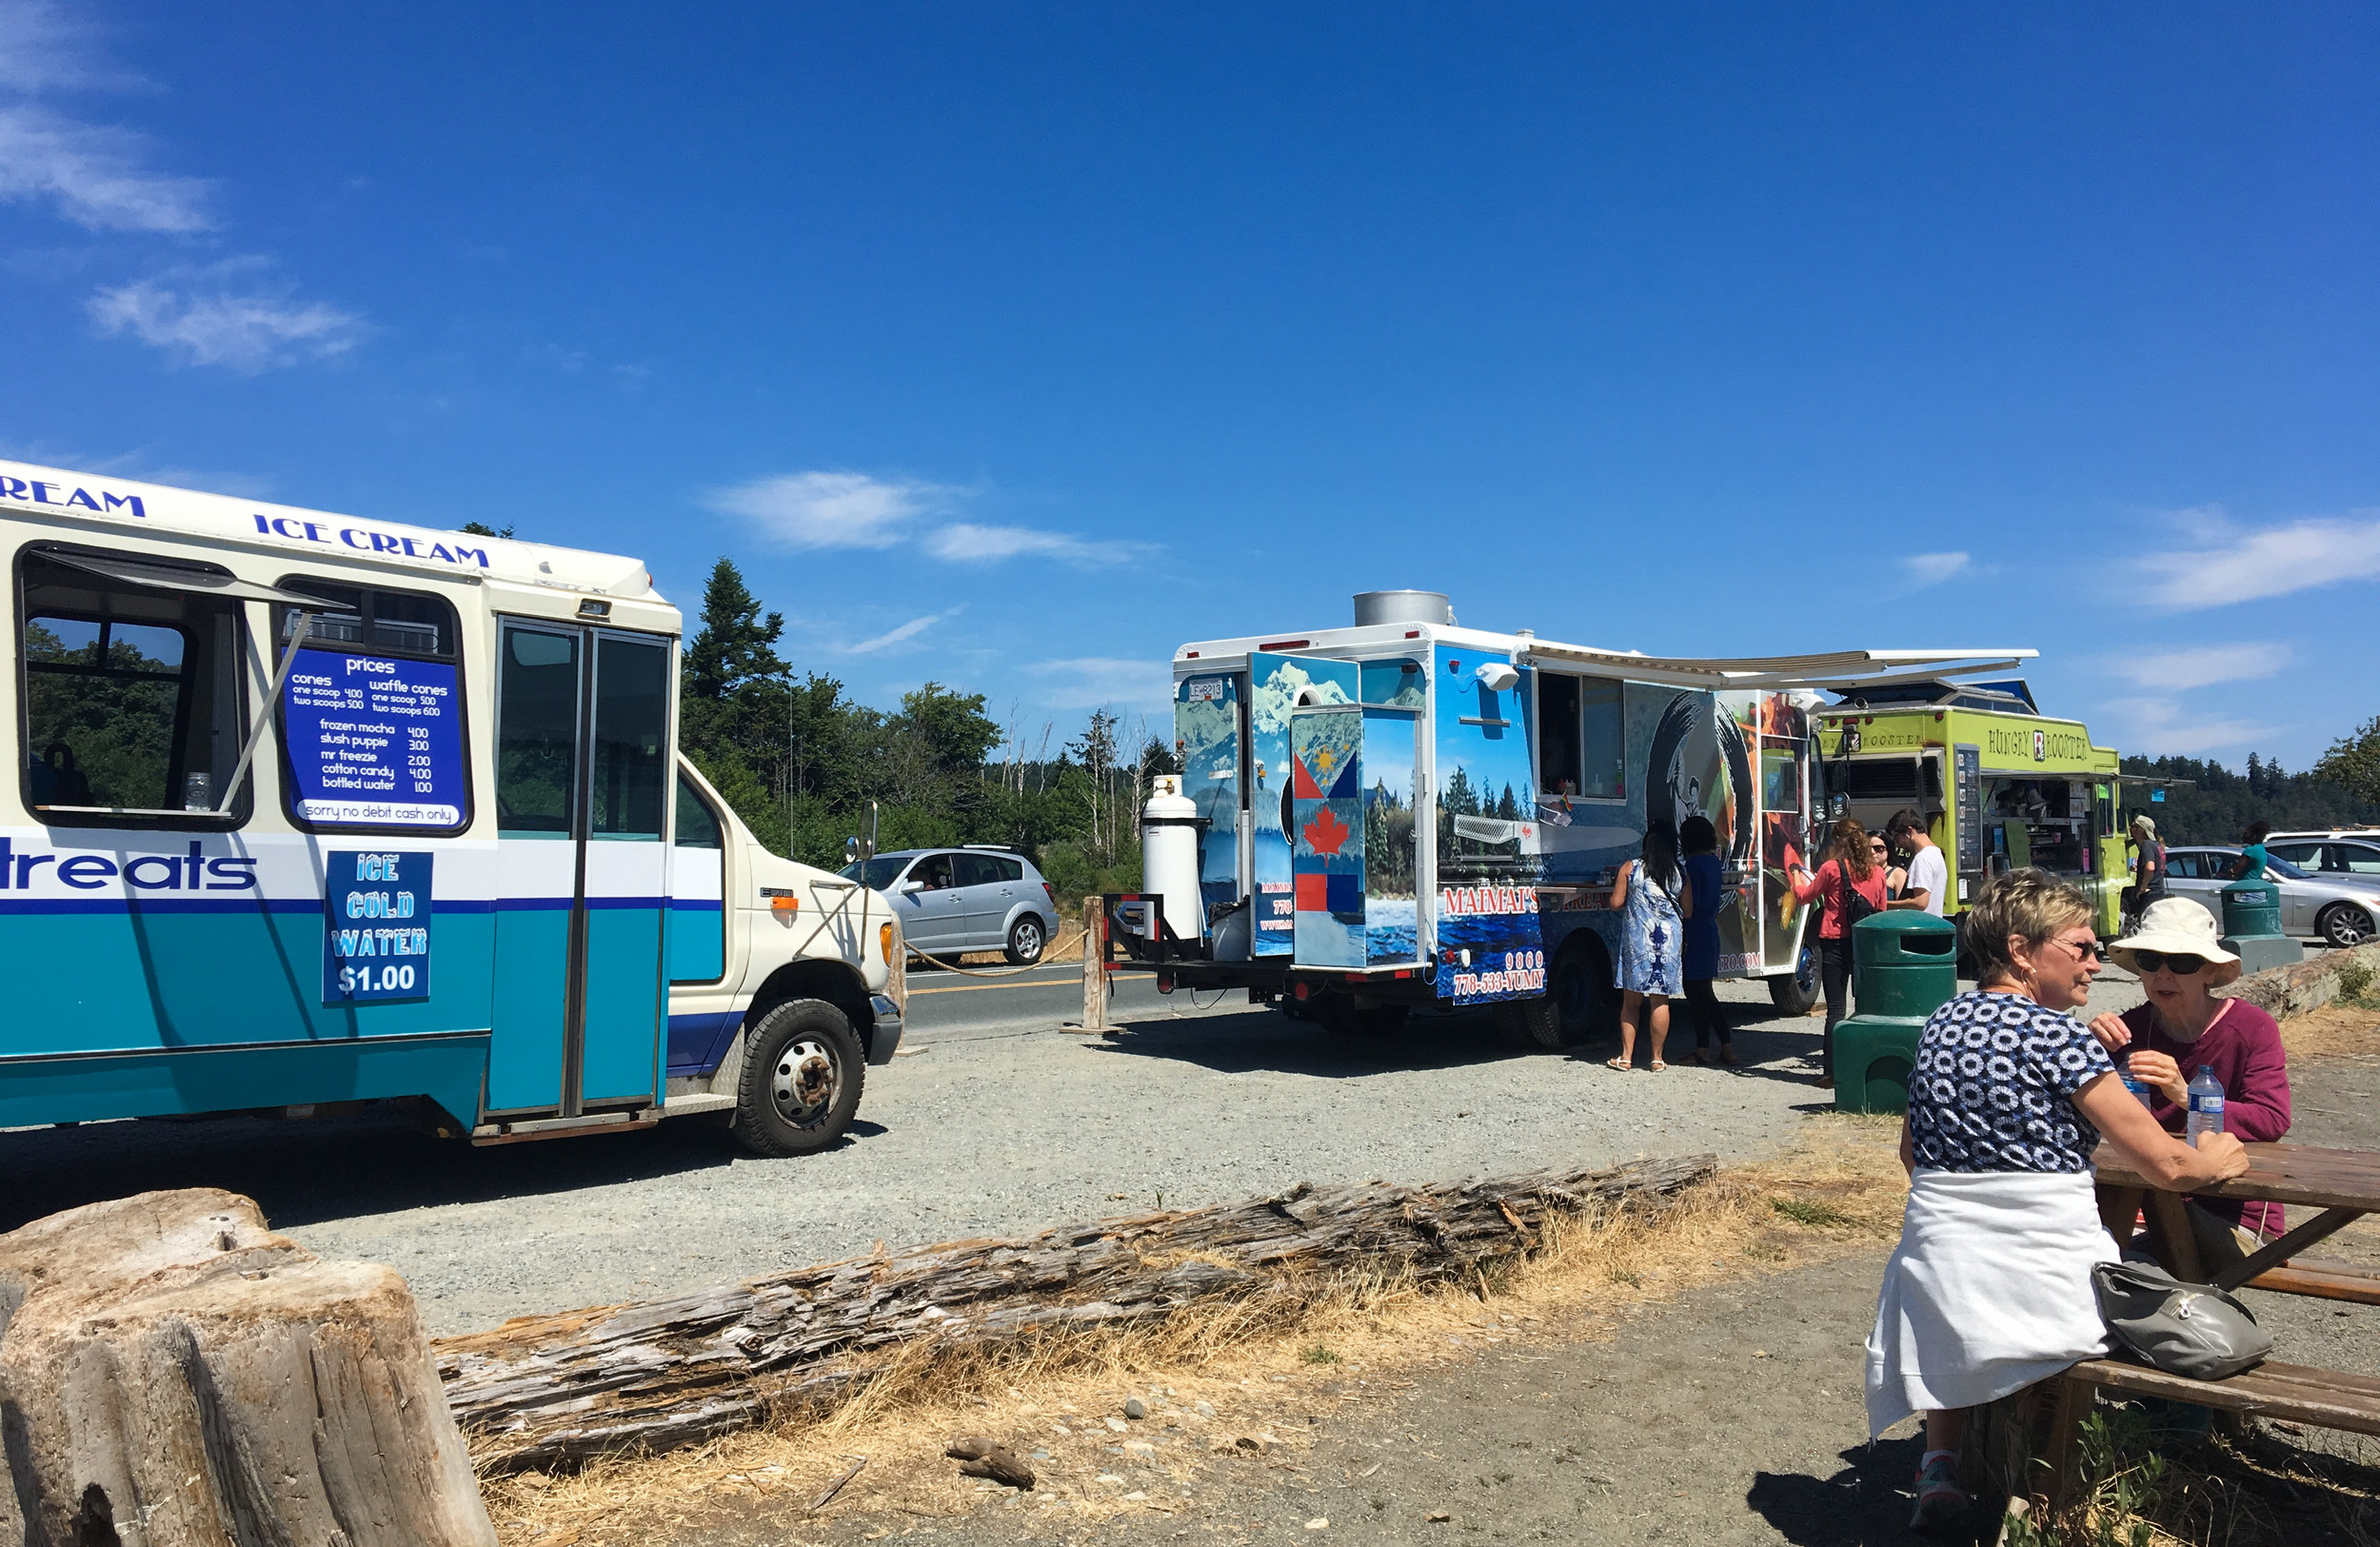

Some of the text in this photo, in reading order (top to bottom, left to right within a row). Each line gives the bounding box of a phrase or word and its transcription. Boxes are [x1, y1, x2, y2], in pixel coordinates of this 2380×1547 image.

[253, 513, 490, 568] ICE CREAM
[346, 658, 395, 675] prices
[291, 673, 332, 686] cones
[369, 679, 448, 697] waffle cones
[292, 686, 363, 699] one scoop 4.00
[371, 693, 436, 706] one scoop 5.00
[293, 696, 365, 710] two scoops 5.00
[372, 703, 441, 717] two scoops 6.00
[319, 718, 428, 739] frozen mocha 4.00
[320, 732, 429, 751] slush puppie 3.00
[1862, 734, 1923, 747] ROOSTER
[1989, 729, 2088, 761] HUNGRY ROOSTER
[321, 749, 431, 766] mr freezie 2.00
[322, 763, 431, 780] cotton candy 4.00
[322, 776, 432, 793] bottled water 1.00
[306, 804, 452, 823] sorry no debit cash only
[0, 837, 258, 890] treats
[356, 853, 400, 882] ICE
[347, 891, 415, 919] COLD
[1273, 900, 1294, 915] 778
[1444, 886, 1540, 914] MAIMAI'S
[331, 927, 427, 958] WATER
[338, 964, 415, 995] $1.00
[1454, 969, 1546, 997] 778-533-YUMY
